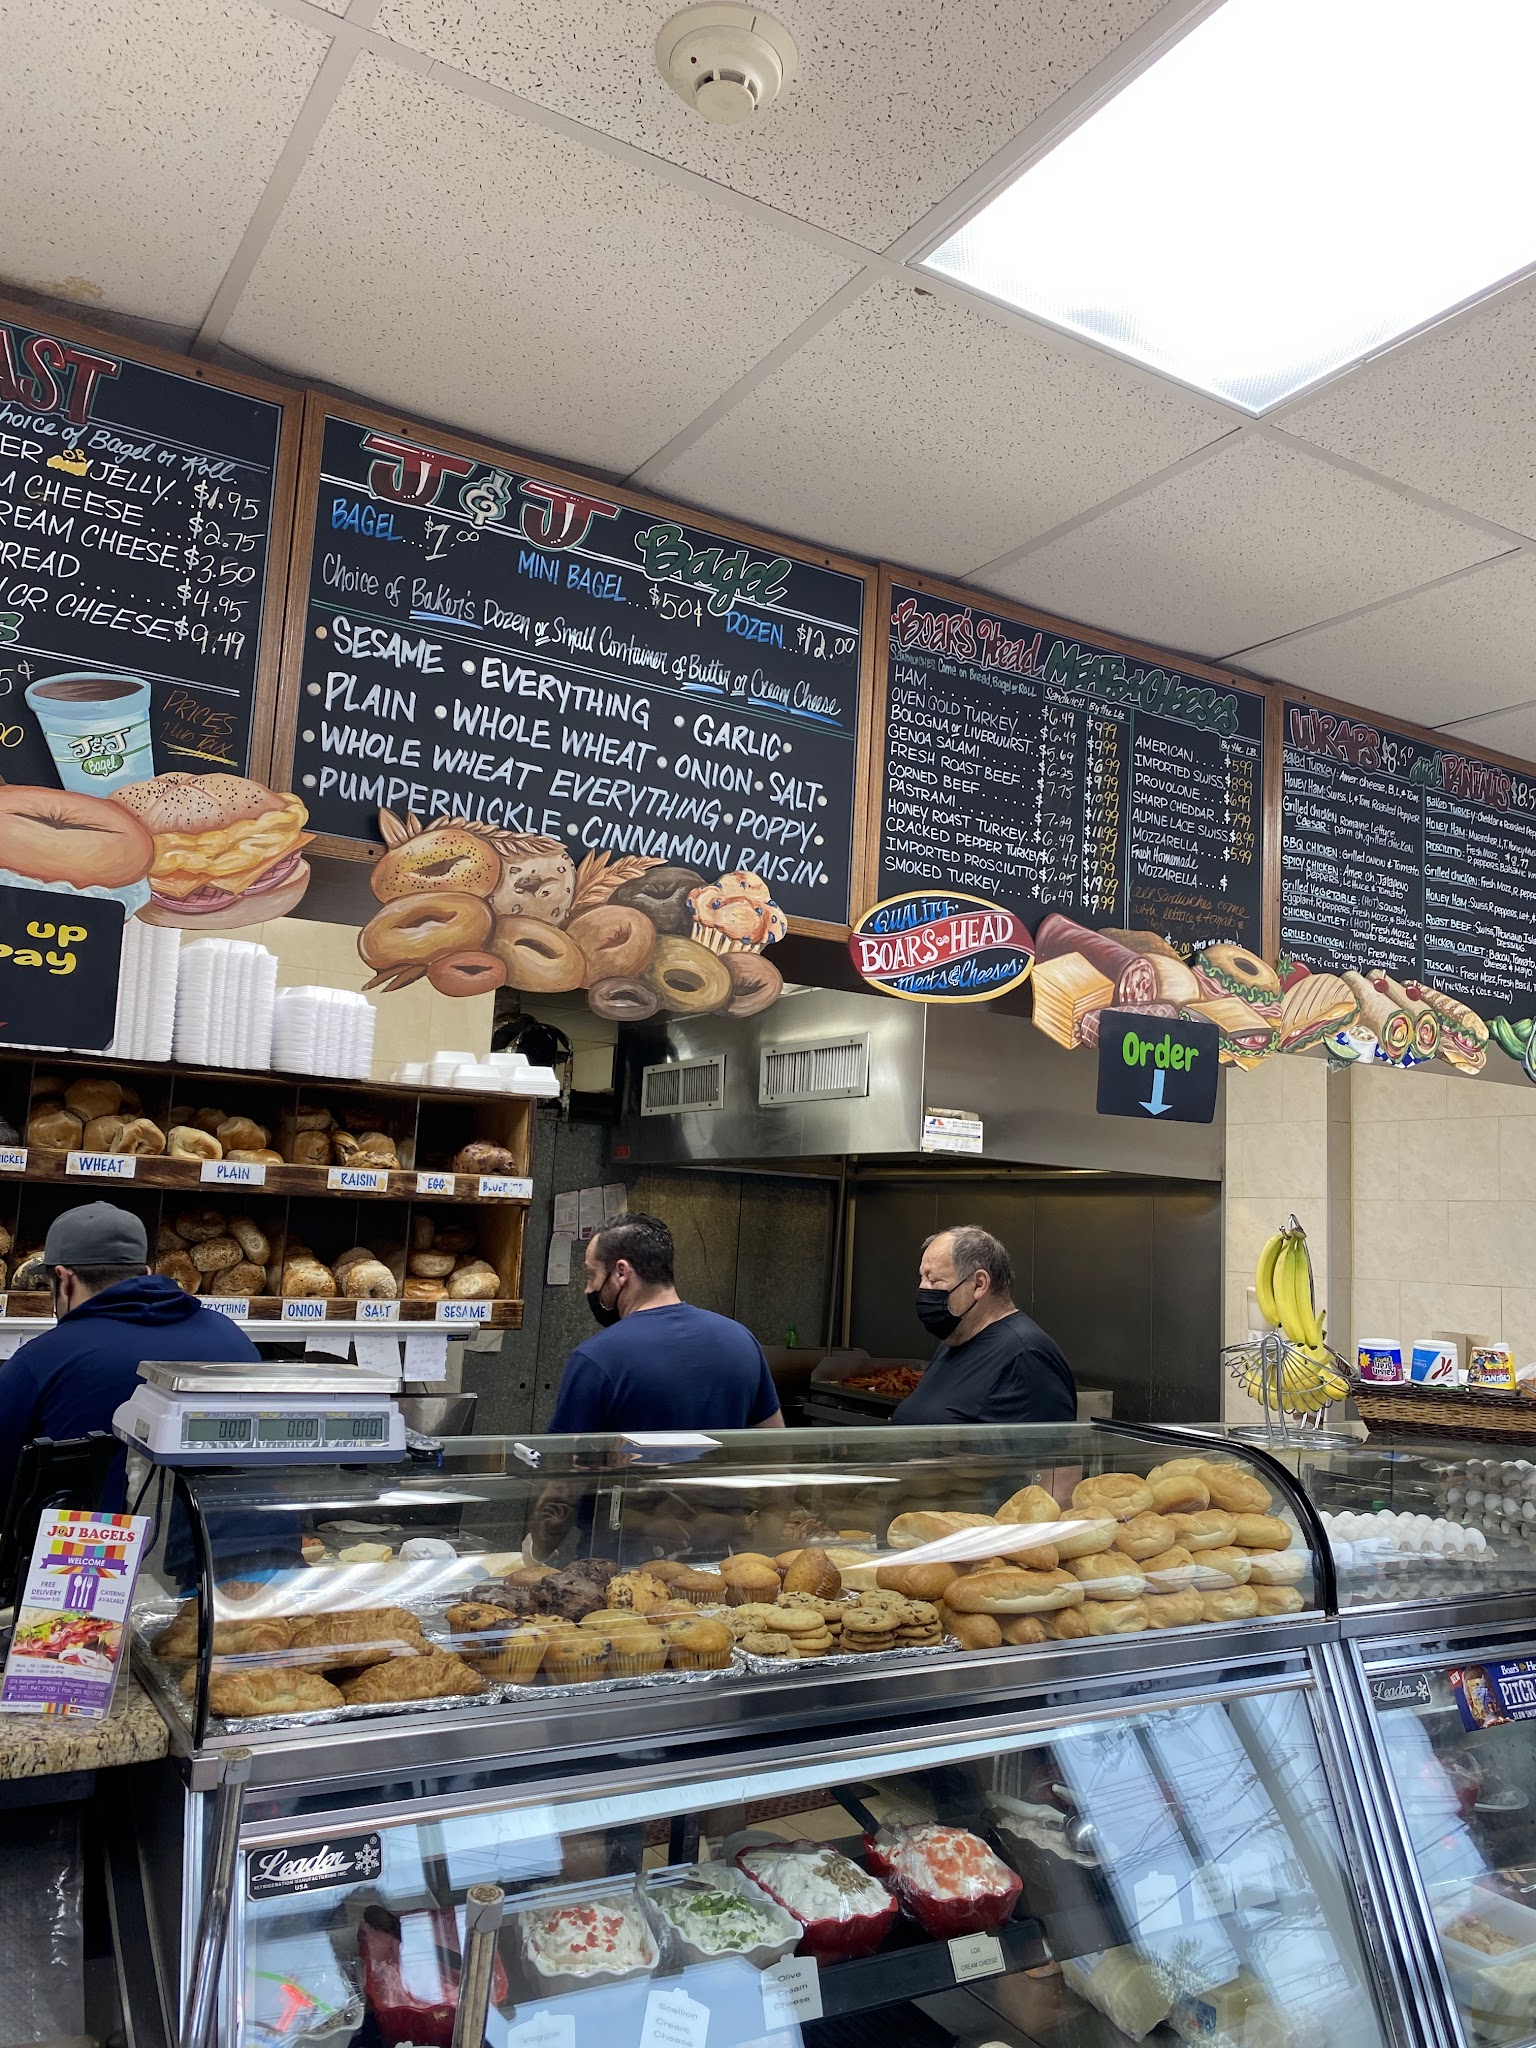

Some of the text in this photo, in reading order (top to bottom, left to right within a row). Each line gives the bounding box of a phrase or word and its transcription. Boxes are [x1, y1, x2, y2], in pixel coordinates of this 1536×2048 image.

[62, 426, 88, 449] of
[87, 430, 154, 464] Bagel
[24, 475, 266, 553] CHEESE $2.75
[331, 498, 405, 542] BAGEL
[360, 431, 793, 616] J & J Bagel
[184, 546, 257, 588] $3.50
[176, 579, 249, 623] $4.95
[517, 550, 560, 585] MINI
[566, 562, 627, 602] BAGEL
[725, 610, 785, 650] DOZEN
[796, 623, 856, 661] $12.00
[322, 552, 379, 596] Choice
[384, 576, 406, 608] of
[483, 598, 531, 639] Dozen
[534, 623, 549, 637] or
[552, 616, 597, 654] Small
[598, 625, 668, 676] Container
[671, 655, 687, 680] of
[688, 653, 731, 691] Butter
[733, 674, 749, 690] or
[750, 668, 791, 706] Cream
[793, 680, 842, 716] Cheese
[976, 619, 1049, 681] Head
[331, 615, 782, 762] SESAME EVERYTHING GARLIC
[895, 664, 1075, 728] HAM $6.49
[162, 690, 238, 735] PRICES
[891, 687, 1077, 747] OVEN GOLD TURKEY $6.49
[324, 671, 824, 812] PLAIN WHOLE WHEAT ONION SALT
[888, 723, 980, 758] GENOA SALAMI
[891, 704, 949, 733] BOLOGNA
[964, 723, 1034, 754] LIVERWURST
[1290, 708, 1381, 770] WRAPS
[891, 741, 1020, 785] FRESH ROAST BEEF
[1135, 735, 1193, 762] AMERICAN
[88, 754, 118, 777] Bagel
[888, 761, 981, 794] CORNED BEEF
[1134, 753, 1190, 779] IMPORTED
[320, 720, 818, 854] WHOLE WHEAT EVERYTHING POPPY
[889, 777, 956, 807] PASTRAMI
[1135, 773, 1200, 800] PROVOLONE
[1132, 791, 1215, 821] SHARP CHEDDAR
[1132, 808, 1195, 834] ALPINE LACE
[318, 765, 825, 888] PUMPERNICKLE CINNAMON RAISIN
[888, 798, 928, 825] HONEY
[932, 810, 972, 828] ROAST
[975, 818, 1027, 846] TURKEY
[886, 817, 1041, 868] CRACKED PEPPER TURKEY
[1132, 826, 1199, 854] MOZZARELLA
[1283, 835, 1303, 850] BBQ
[886, 836, 960, 863] IMPORTED
[964, 853, 1038, 881] PROSCIUTTO
[1153, 846, 1199, 870] Homemade
[885, 856, 1074, 907] SMOKED TURKEY $6.49
[1138, 862, 1198, 888] MOZZARELLA
[26, 921, 88, 948] up
[859, 915, 1014, 973] BOARS HEAD
[948, 965, 962, 986] &
[1122, 1031, 1199, 1072] Order
[79, 1157, 125, 1173] WHEAT
[217, 1165, 250, 1180] PLAIN
[340, 1172, 377, 1187] RAISIN
[427, 1177, 446, 1190] EGG
[288, 1304, 324, 1317] ONION
[364, 1305, 392, 1318] SALT
[444, 1305, 486, 1318] SESAME
[78, 1527, 135, 1542] BAGELS
[67, 1557, 105, 1567] WELCOME
[31, 1588, 62, 1596] DELIVERY
[1372, 1681, 1418, 1701] Leader
[251, 1845, 355, 1882] Leader
[294, 1883, 309, 1891] USA
[961, 1957, 999, 1971] CREAM CHEESE
[971, 1947, 981, 1955] LOX
[777, 1970, 802, 1983] Olive
[777, 1983, 808, 1997] Cream
[658, 2002, 699, 2020] Scallion
[774, 1996, 810, 2010] Cheese
